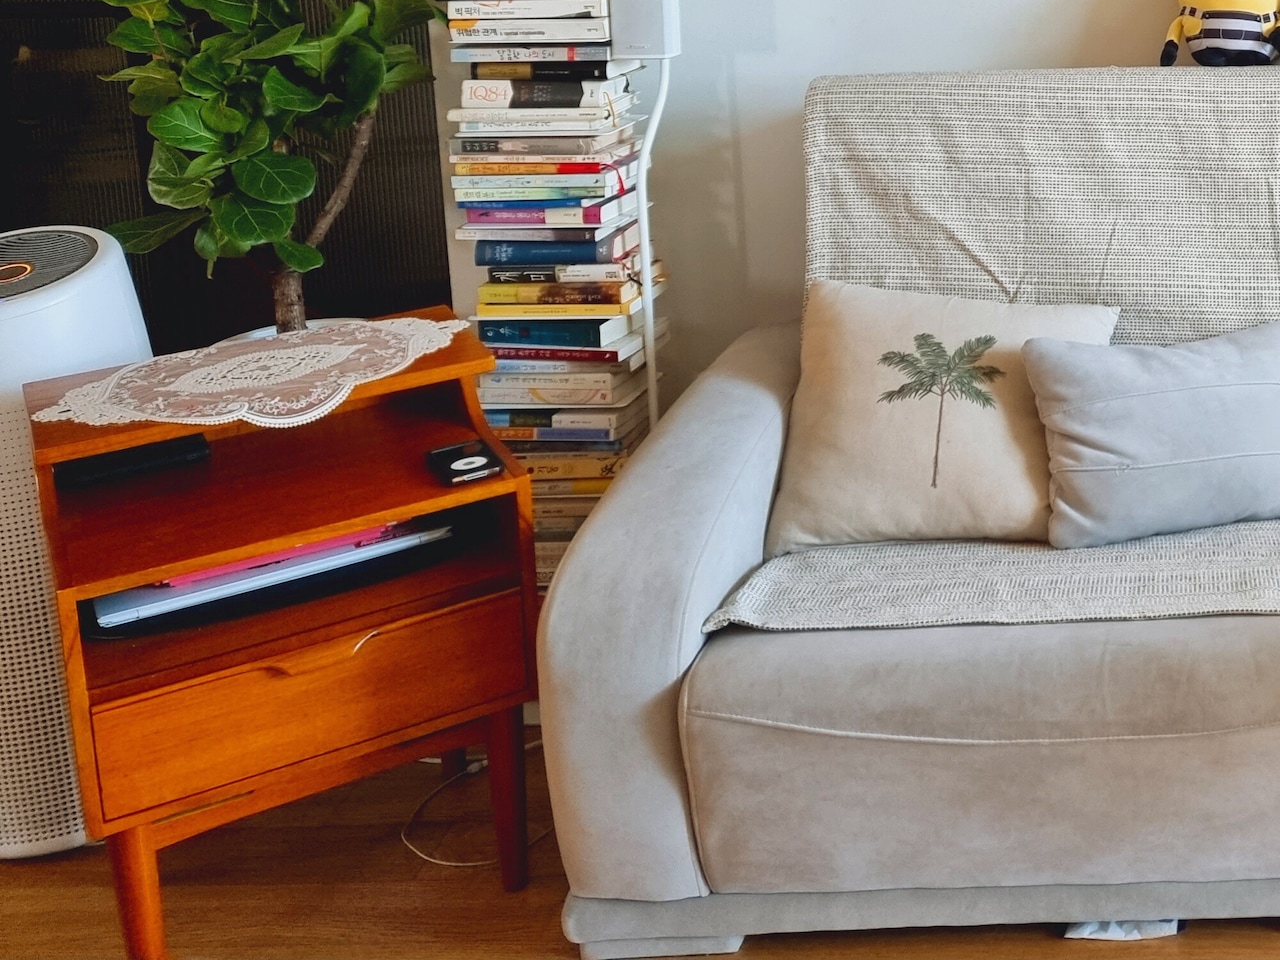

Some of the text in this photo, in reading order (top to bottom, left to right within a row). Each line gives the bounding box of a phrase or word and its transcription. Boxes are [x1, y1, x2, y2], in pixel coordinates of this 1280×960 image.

[455, 6, 481, 17] 빅 픽처
[456, 28, 498, 37] 위험한 관계
[496, 49, 521, 61] 달콤한
[523, 50, 539, 59] 나의
[541, 49, 555, 59] 도시
[468, 85, 510, 102] 1Q84
[491, 271, 554, 283] 개미
